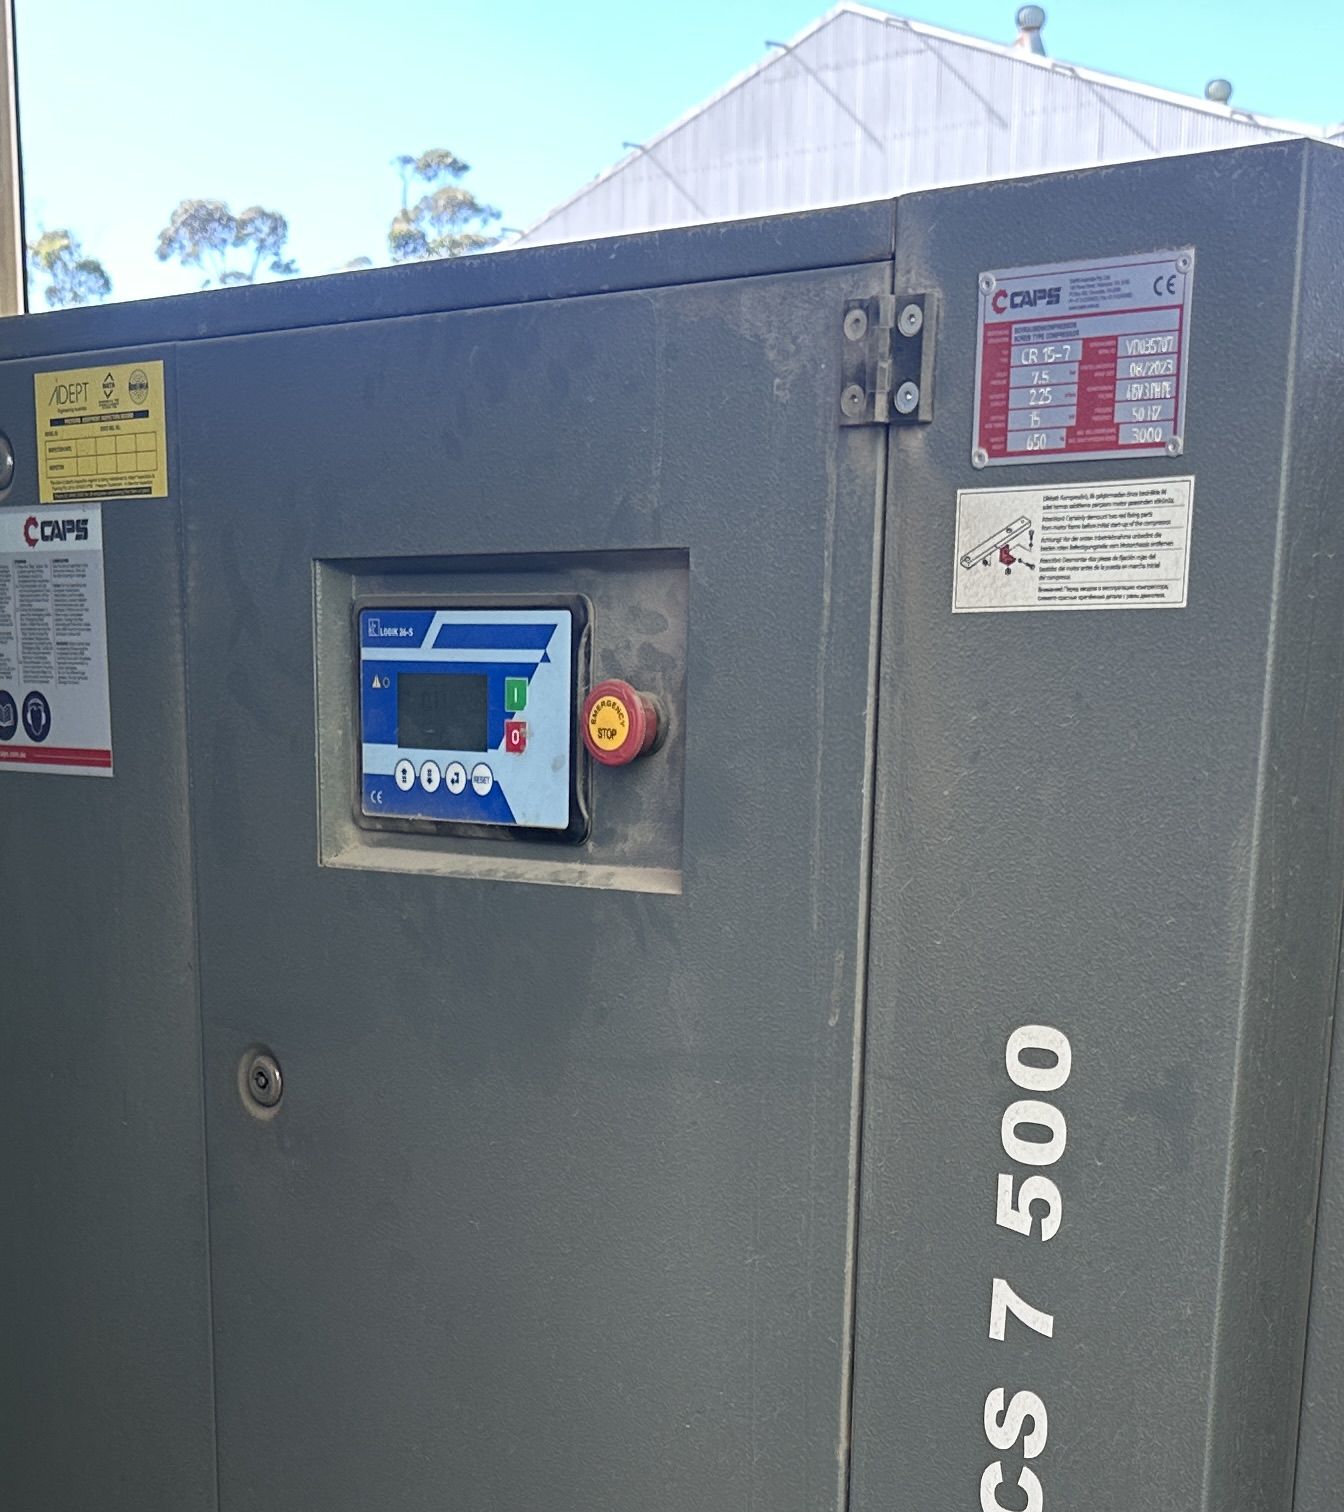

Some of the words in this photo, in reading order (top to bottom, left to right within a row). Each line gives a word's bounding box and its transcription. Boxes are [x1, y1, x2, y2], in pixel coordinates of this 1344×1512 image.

[1153, 274, 1176, 296] CE
[1009, 286, 1062, 310] CAPS
[1021, 348, 1038, 364] CR
[1042, 345, 1071, 362] 15-7
[1031, 370, 1050, 384] 7.5
[49, 380, 90, 406] ADEPT
[1026, 433, 1047, 450] 650
[1132, 427, 1163, 443] 3000
[40, 518, 89, 542] CAPS
[591, 700, 625, 727] EMERGENCY
[597, 727, 617, 740] STOP
[473, 775, 491, 785] RESET
[370, 790, 383, 804] CE
[995, 1024, 1072, 1242] 500
[988, 1278, 1054, 1341] 7
